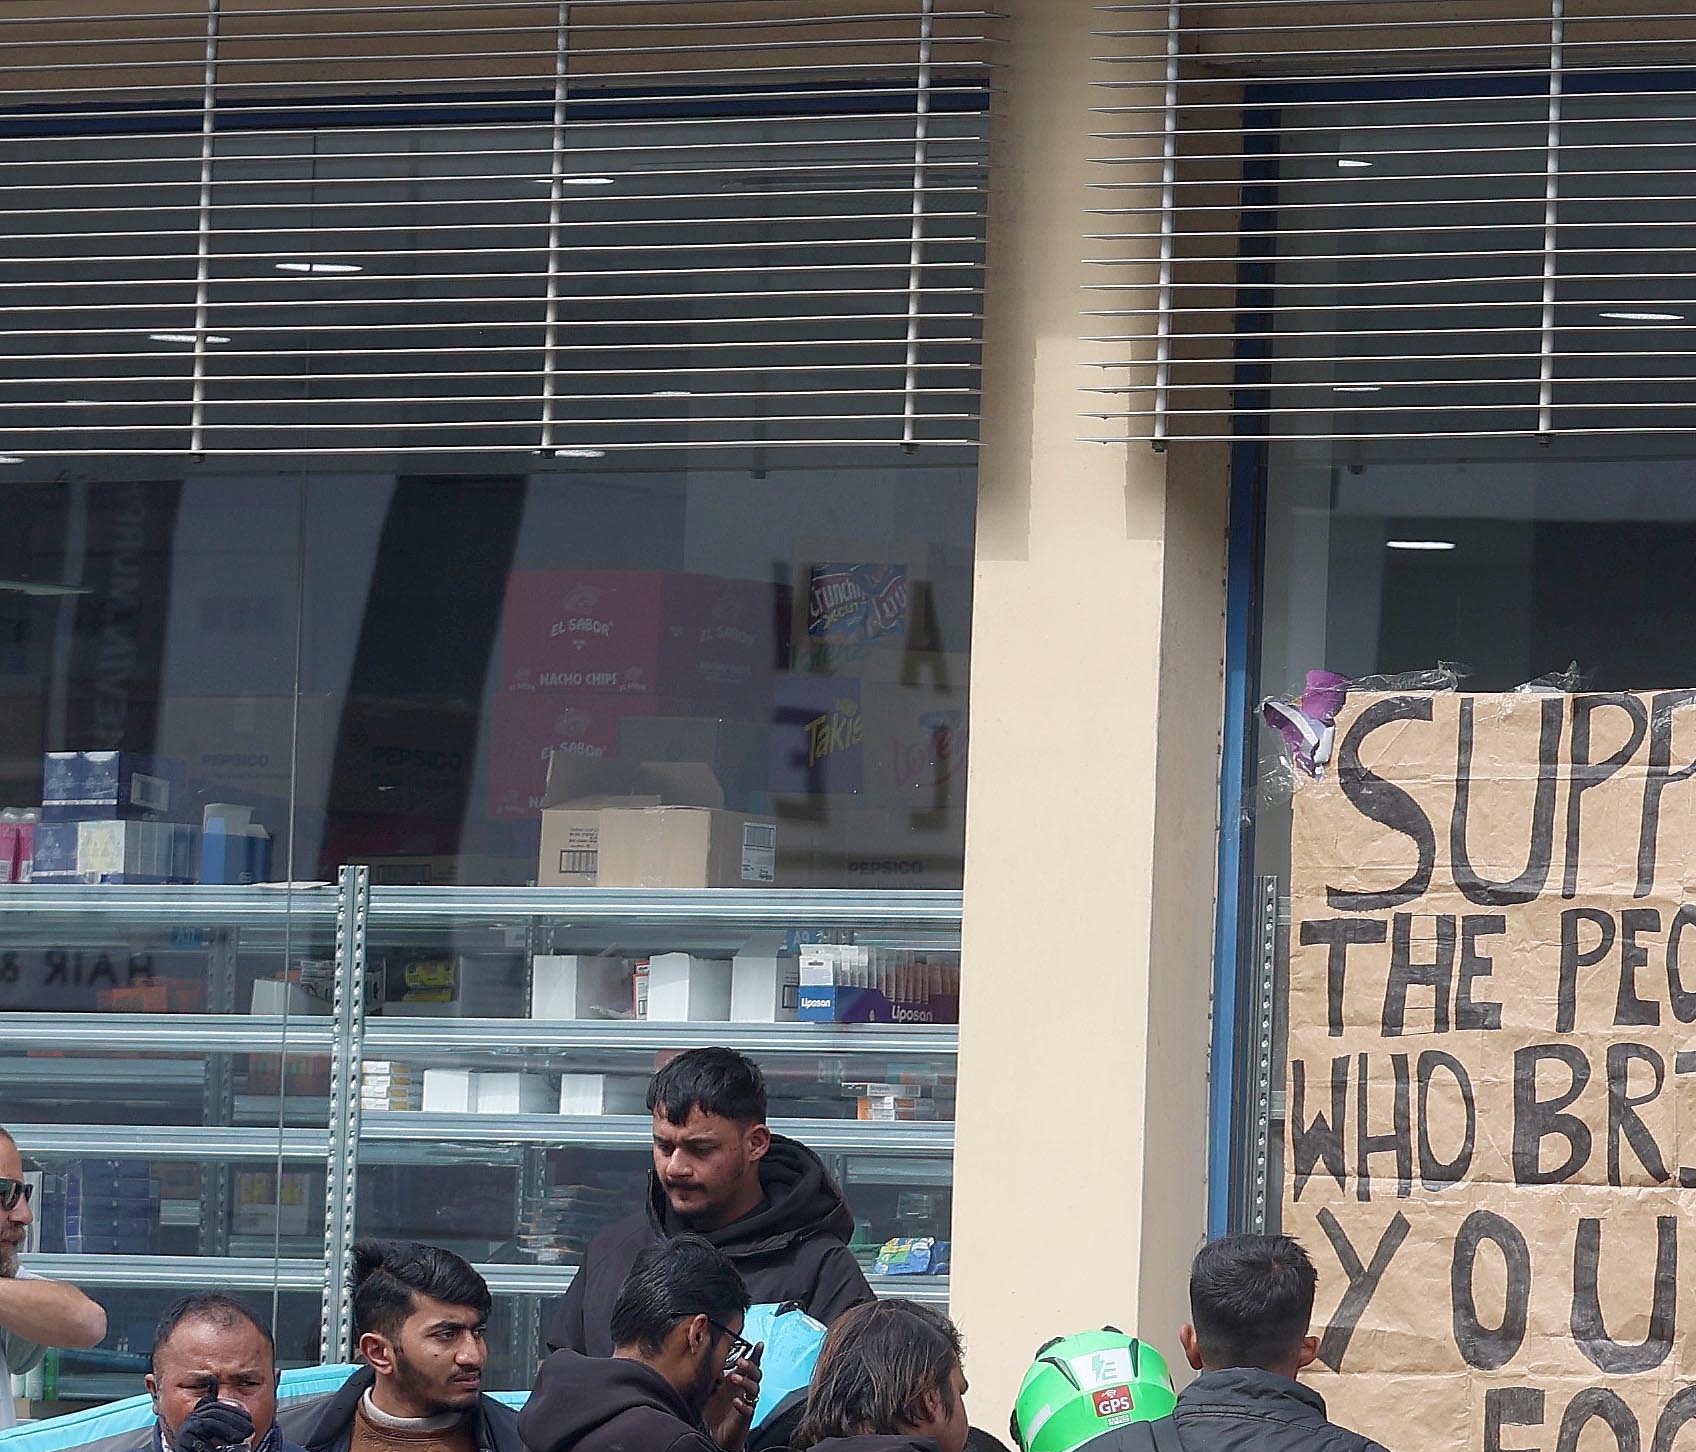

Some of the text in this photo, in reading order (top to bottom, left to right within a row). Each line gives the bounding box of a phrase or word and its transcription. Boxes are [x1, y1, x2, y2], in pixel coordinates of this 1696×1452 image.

[551, 617, 611, 638] EL SABOR
[540, 672, 618, 686] NACHO CHIPS
[371, 746, 463, 770] PEPSICO
[1298, 911, 1509, 1038] THE
[801, 997, 832, 1010] Liposan
[890, 1004, 934, 1023] Liposan
[1291, 1050, 1477, 1204] WHO
[1314, 1206, 1678, 1375] YOU
[1098, 1395, 1130, 1417] GPS
